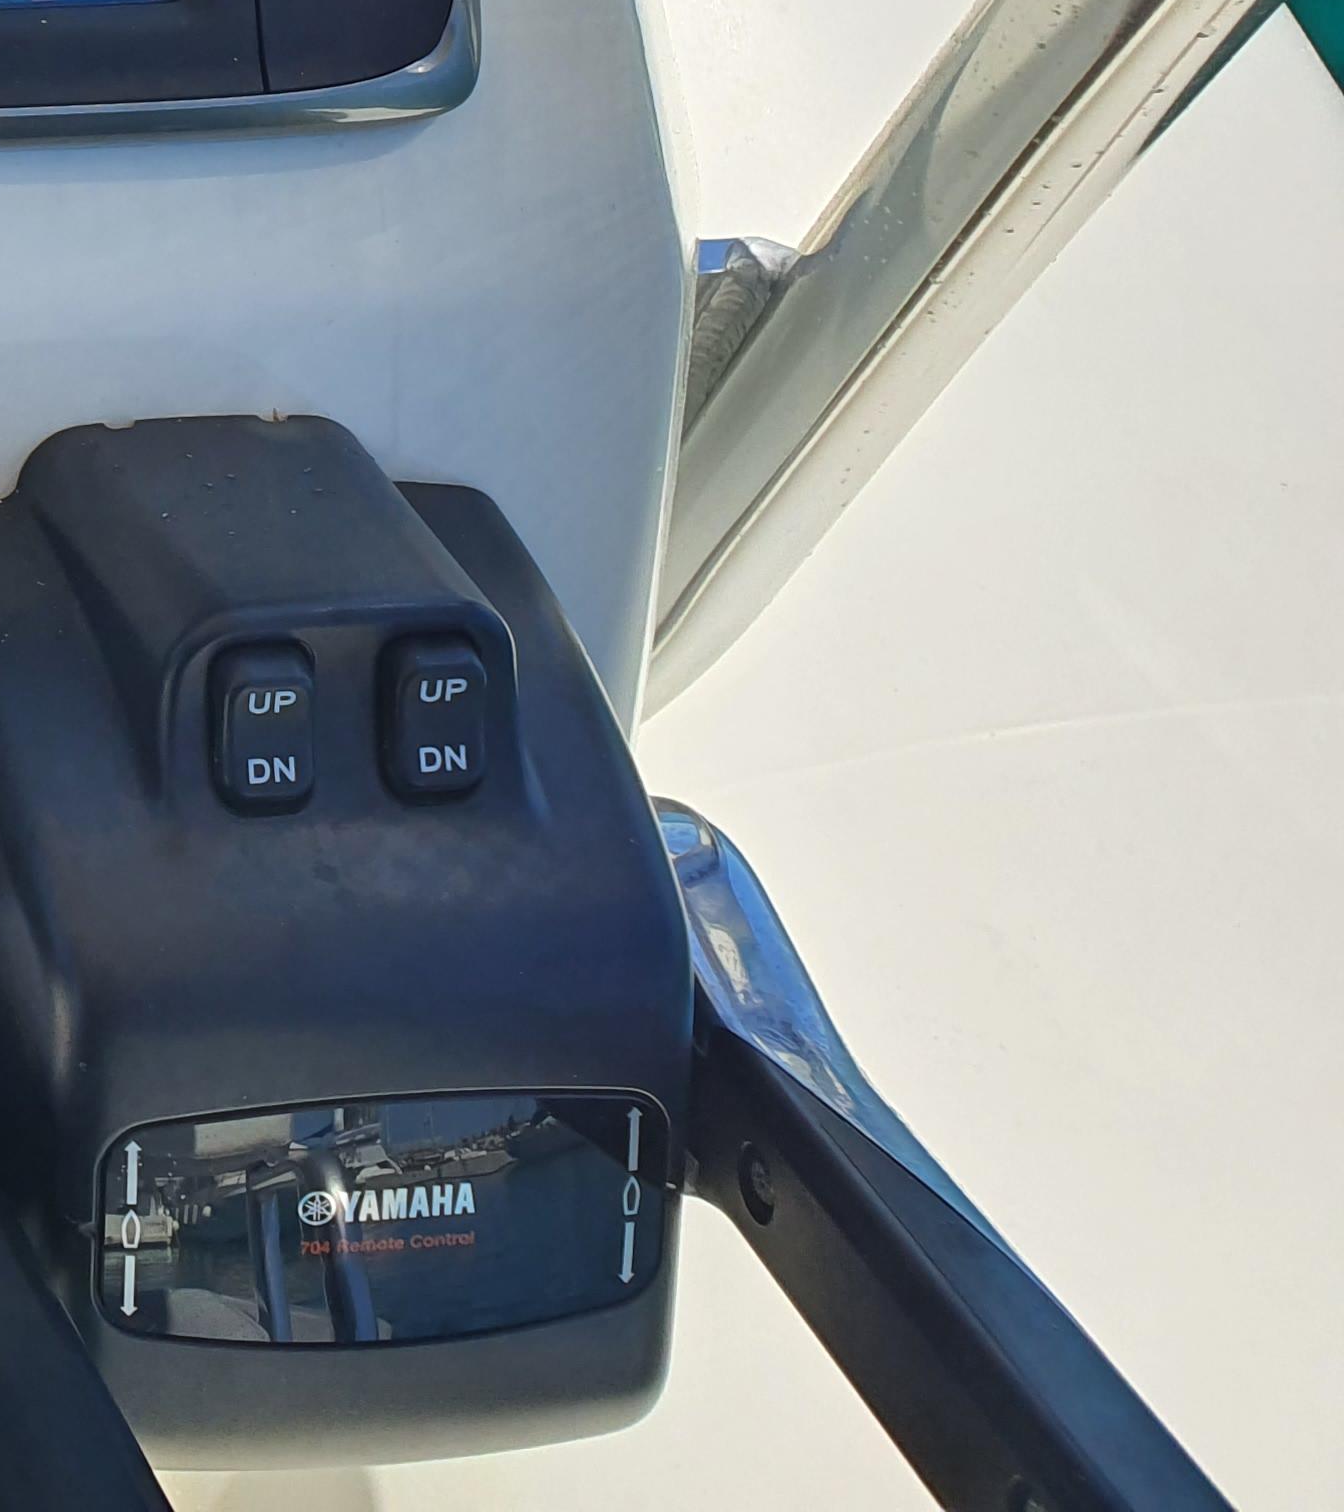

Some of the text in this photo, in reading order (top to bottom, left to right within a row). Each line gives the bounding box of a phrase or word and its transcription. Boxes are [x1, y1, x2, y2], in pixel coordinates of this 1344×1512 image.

[248, 690, 297, 715] UP
[419, 678, 468, 703] UP
[247, 756, 296, 785] DN
[419, 744, 467, 773] DN
[340, 1182, 475, 1223] YAMAHA
[300, 1231, 475, 1256] 704 Remote Control
